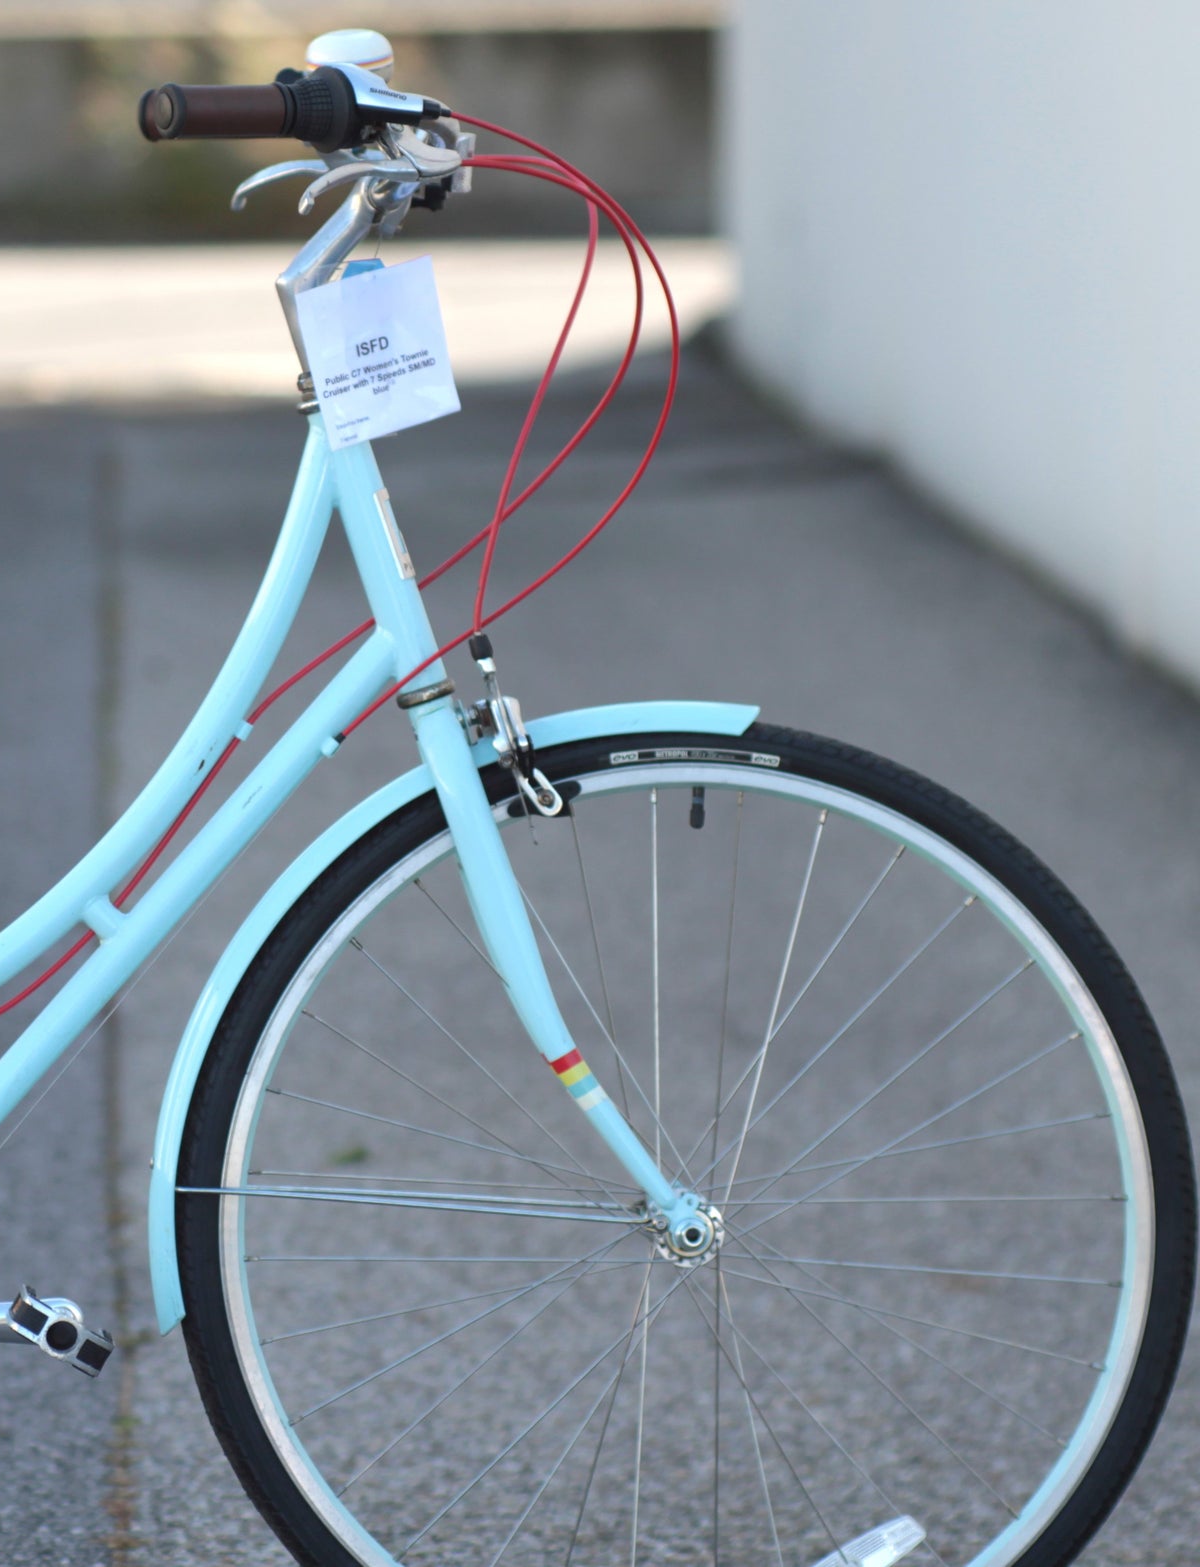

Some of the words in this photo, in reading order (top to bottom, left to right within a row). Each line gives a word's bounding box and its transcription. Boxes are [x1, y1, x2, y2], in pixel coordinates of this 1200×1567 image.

[356, 336, 389, 357] ISFD
[323, 385, 351, 398] Cruiser
[353, 379, 369, 389] with
[370, 375, 375, 384] 7
[377, 367, 406, 382] Speeds
[408, 357, 436, 372] SM/MD
[325, 373, 349, 386] Public
[351, 368, 361, 378] C7
[363, 358, 399, 374] Women's
[400, 349, 429, 362] Townie
[372, 384, 389, 395] blue
